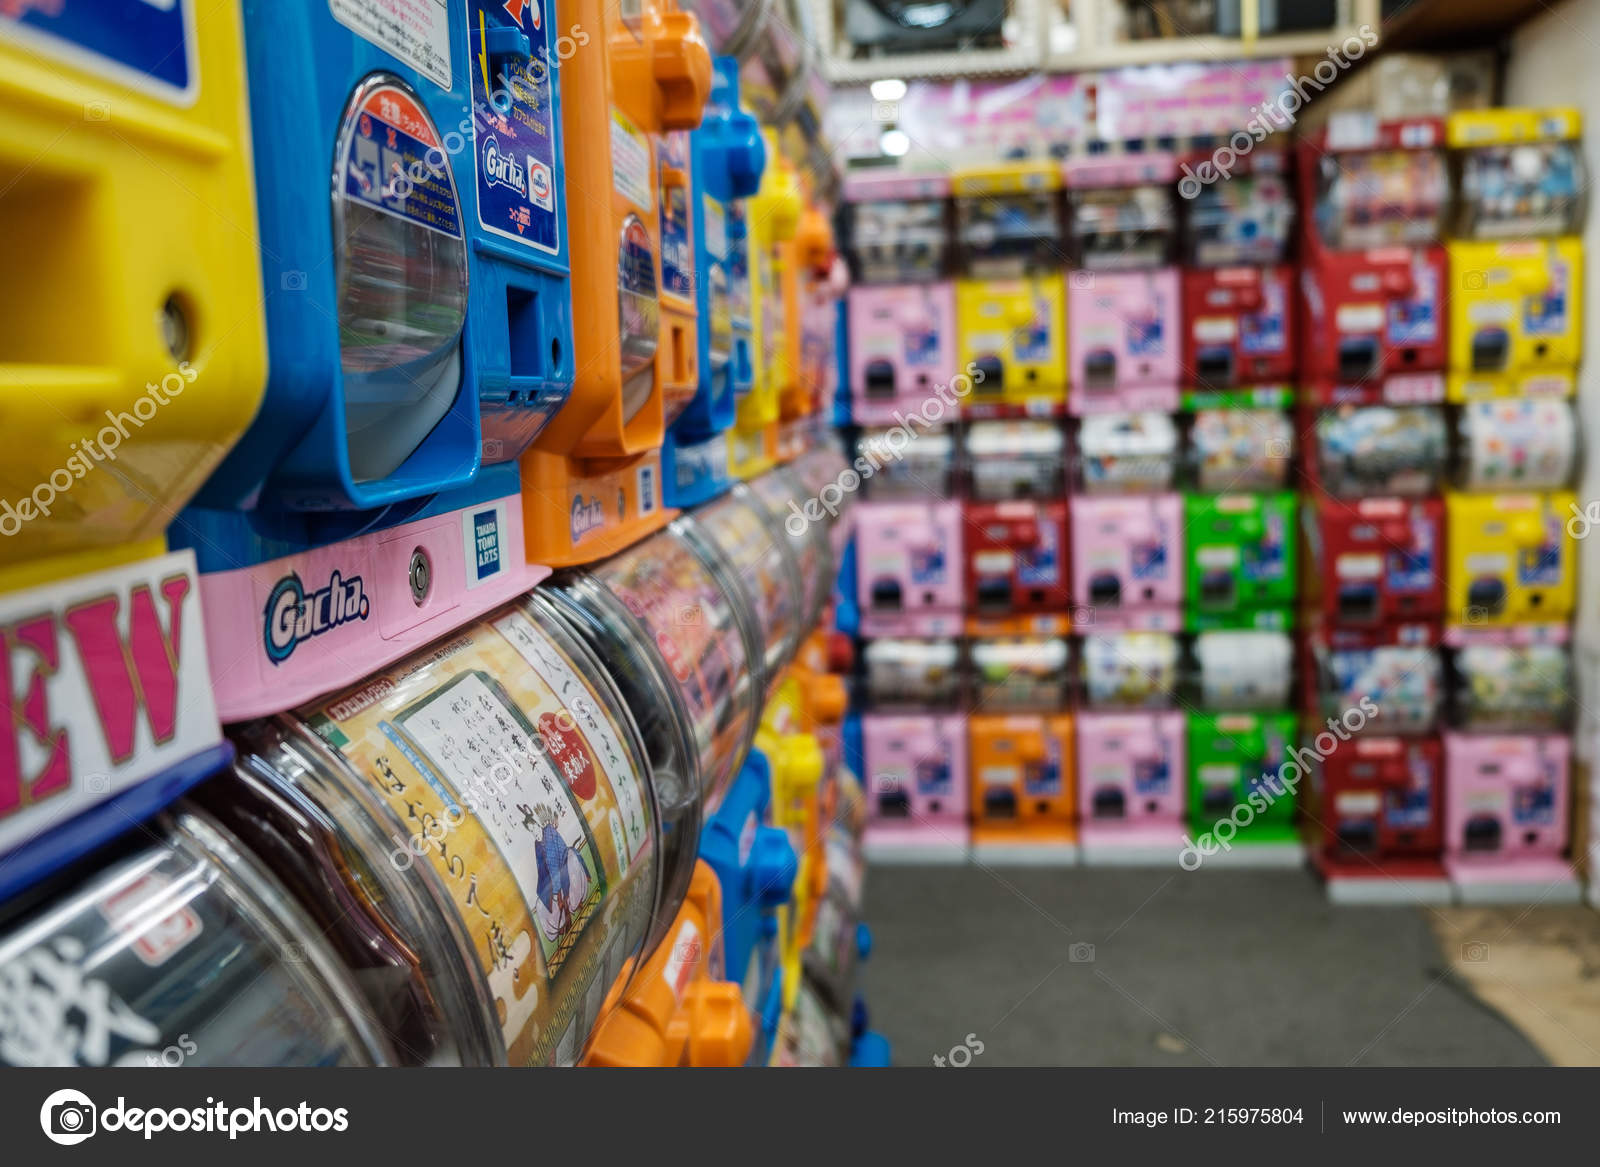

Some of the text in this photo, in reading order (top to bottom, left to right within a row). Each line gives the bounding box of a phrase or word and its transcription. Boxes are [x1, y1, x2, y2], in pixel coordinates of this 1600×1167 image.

[477, 534, 497, 551] TOMY
[478, 547, 498, 567] ARTS
[263, 569, 370, 665] Gacha.
